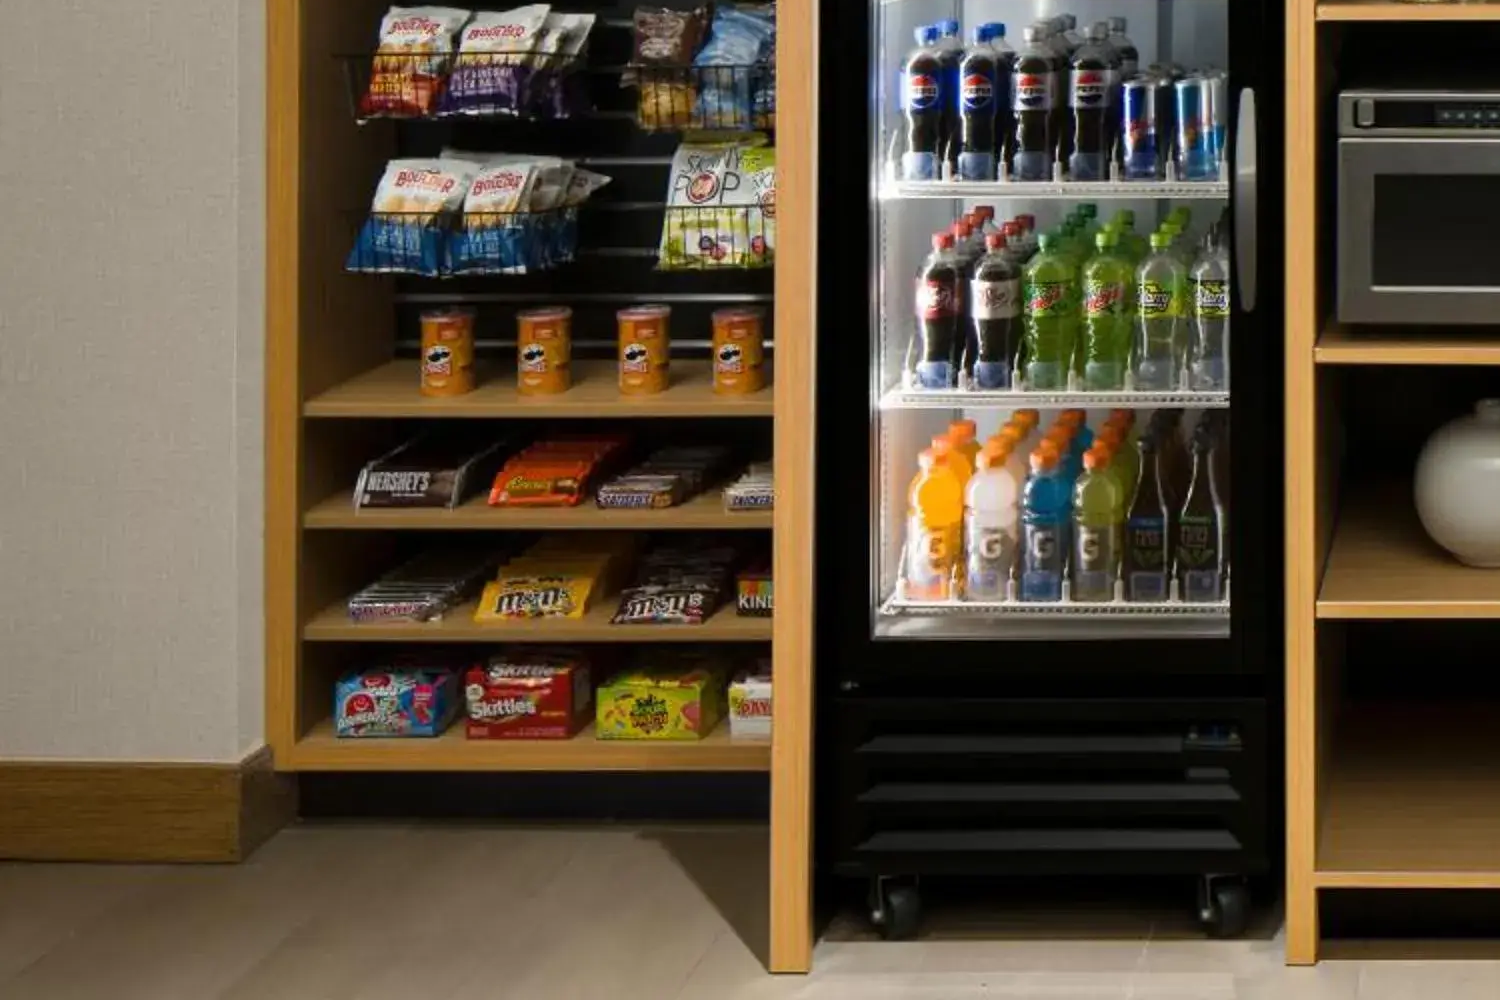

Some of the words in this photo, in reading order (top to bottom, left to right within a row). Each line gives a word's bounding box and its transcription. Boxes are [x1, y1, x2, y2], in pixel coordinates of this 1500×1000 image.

[396, 171, 455, 193] BOULDER
[473, 174, 523, 196] BOULDER
[367, 471, 432, 491] HERSHEY'S
[471, 698, 537, 719] Skittles
